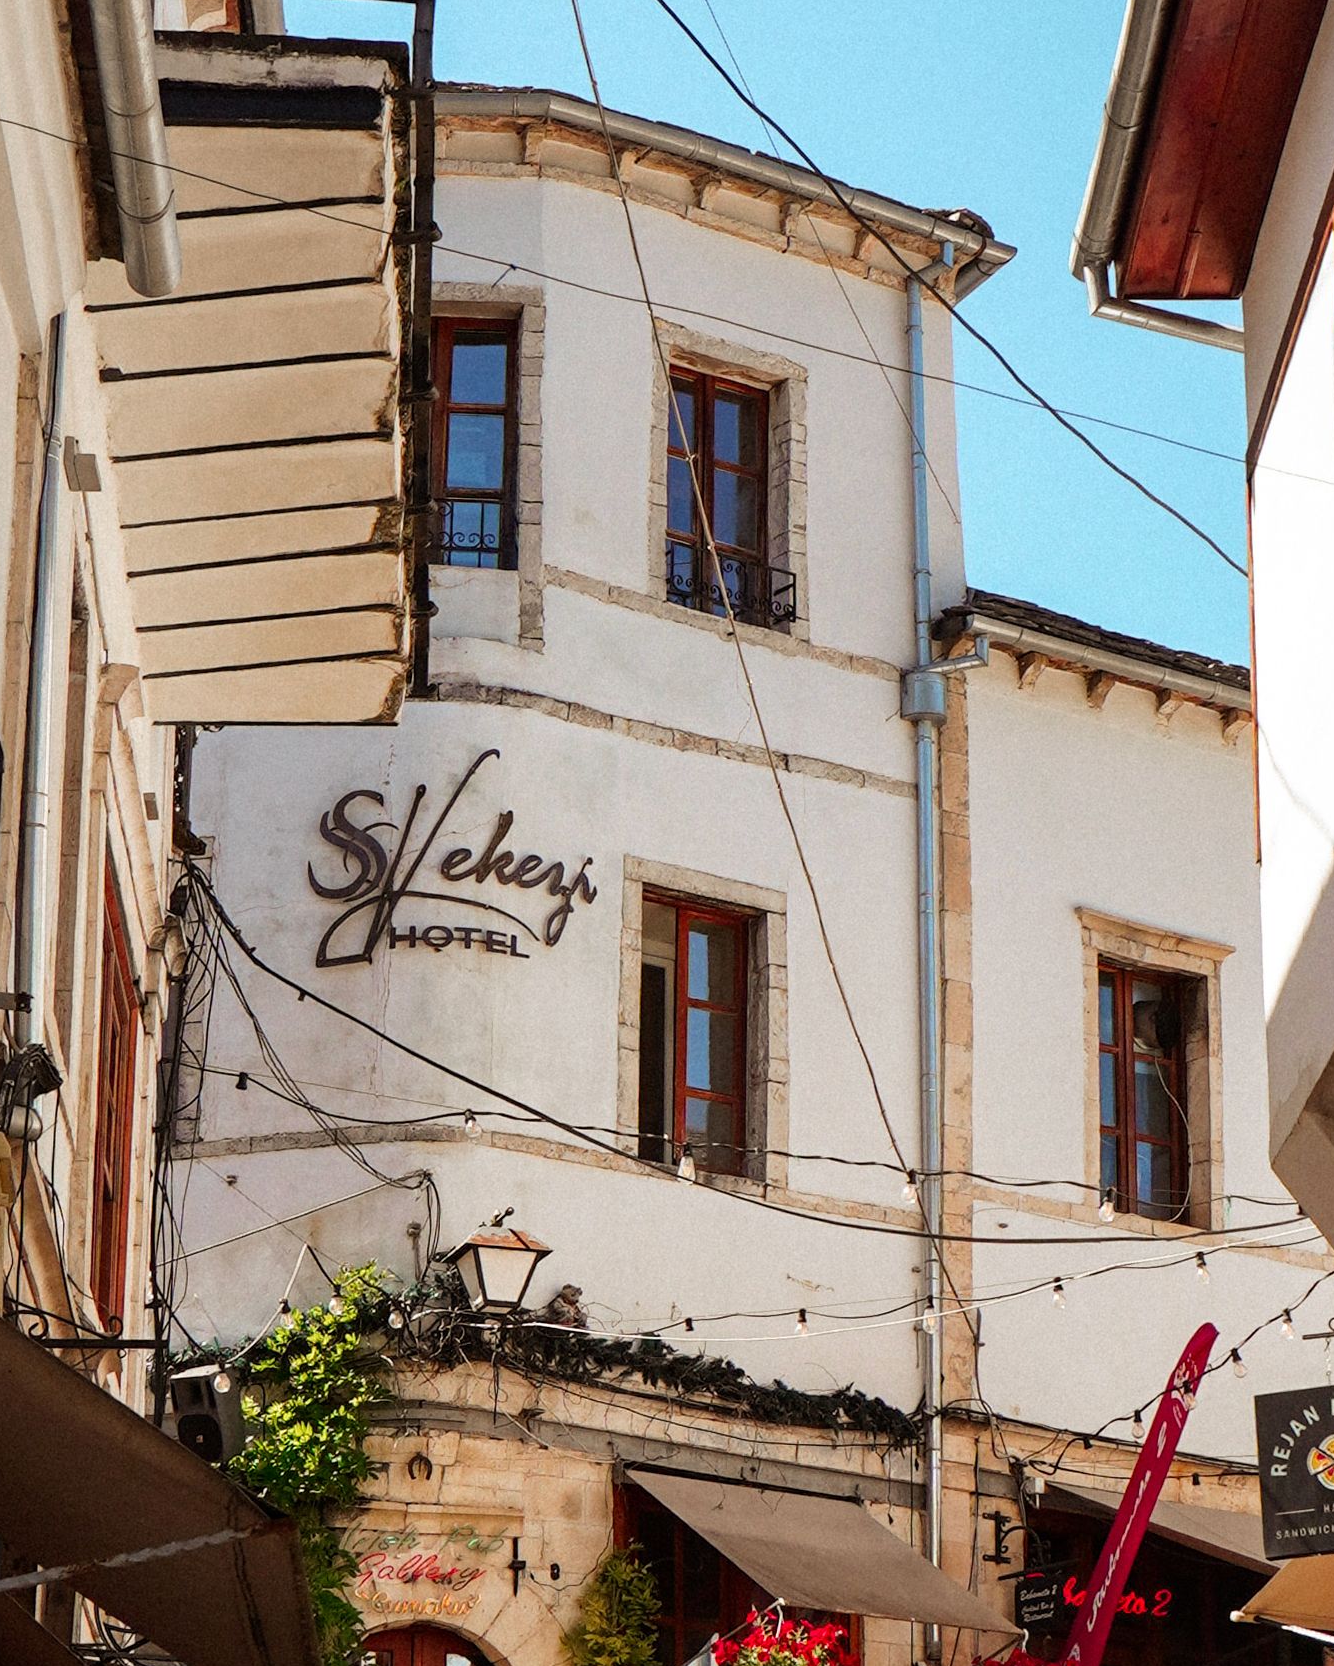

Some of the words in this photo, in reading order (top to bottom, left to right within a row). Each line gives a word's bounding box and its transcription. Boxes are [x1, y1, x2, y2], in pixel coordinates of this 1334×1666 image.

[389, 925, 530, 959] HOTEL
[1270, 1405, 1321, 1477] REJAN
[357, 1551, 487, 1591] Gallery
[1150, 1588, 1173, 1617] 2
